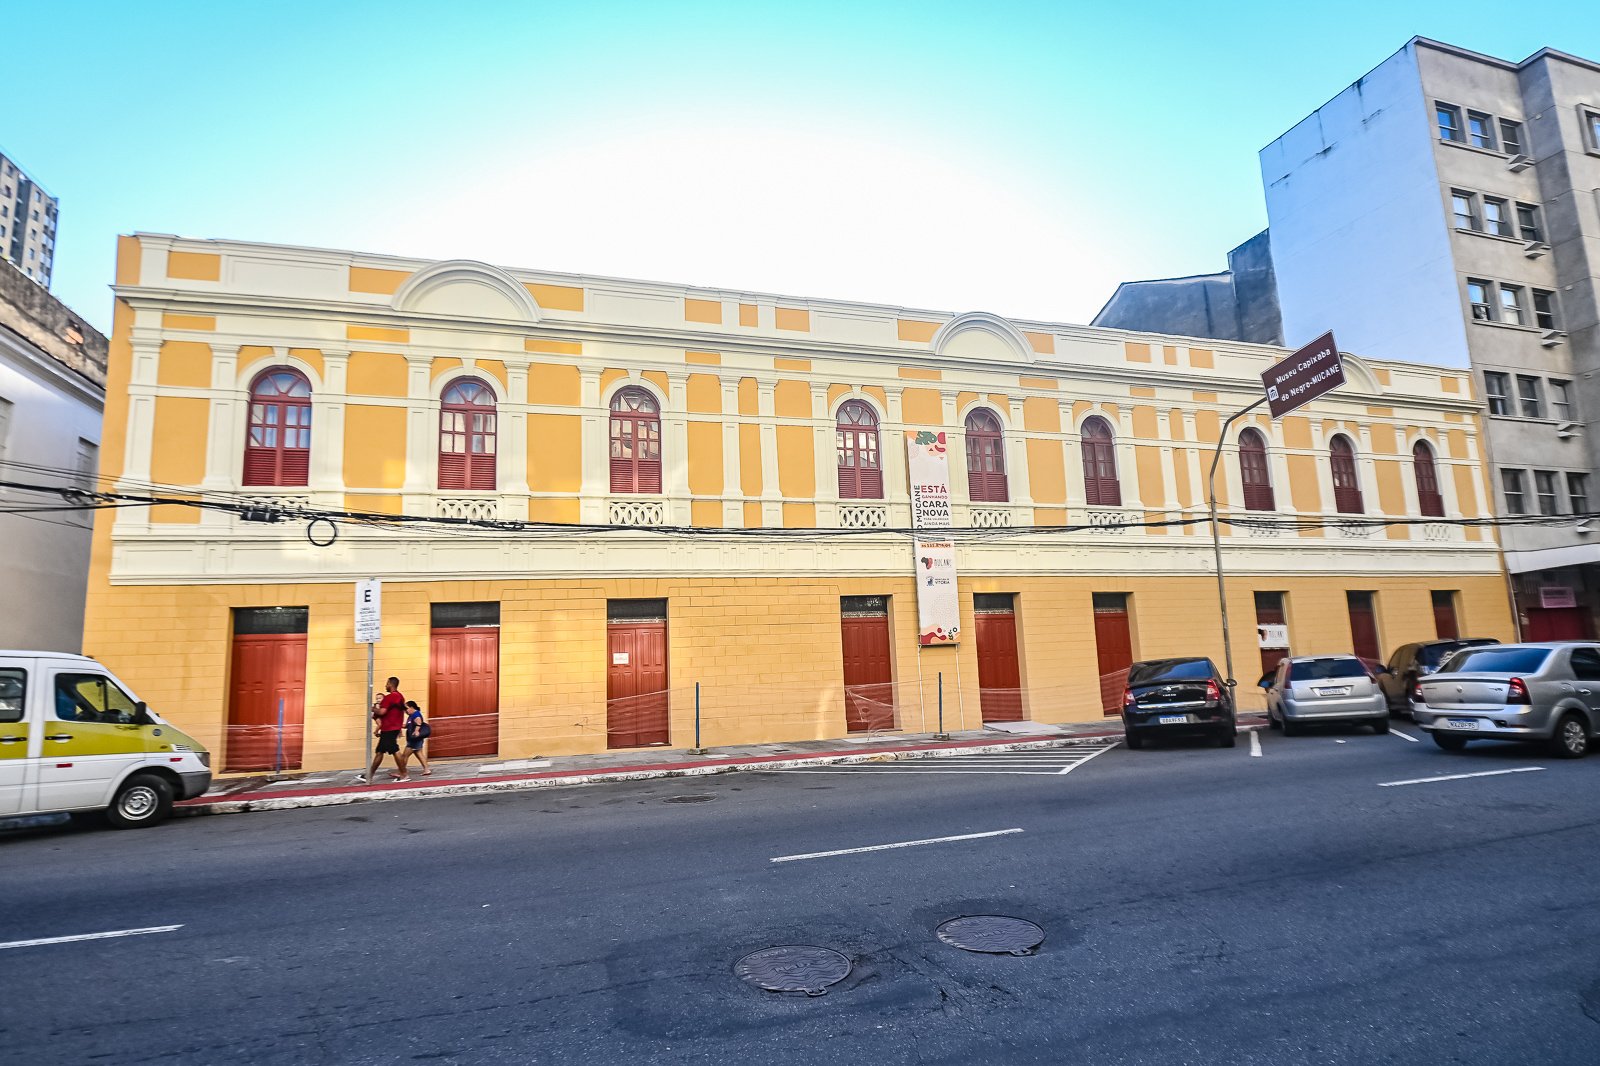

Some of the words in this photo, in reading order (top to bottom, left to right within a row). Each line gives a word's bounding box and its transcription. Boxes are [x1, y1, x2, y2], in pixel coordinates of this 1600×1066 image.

[1276, 369, 1297, 384] Museu
[1298, 349, 1331, 371] Capixaba
[1281, 393, 1290, 401] do
[1290, 364, 1340, 396] Negro-MUCANE
[921, 484, 947, 493] ESTÁ
[914, 485, 922, 522] MUCANE
[922, 500, 948, 508] CARA
[364, 590, 371, 602] E
